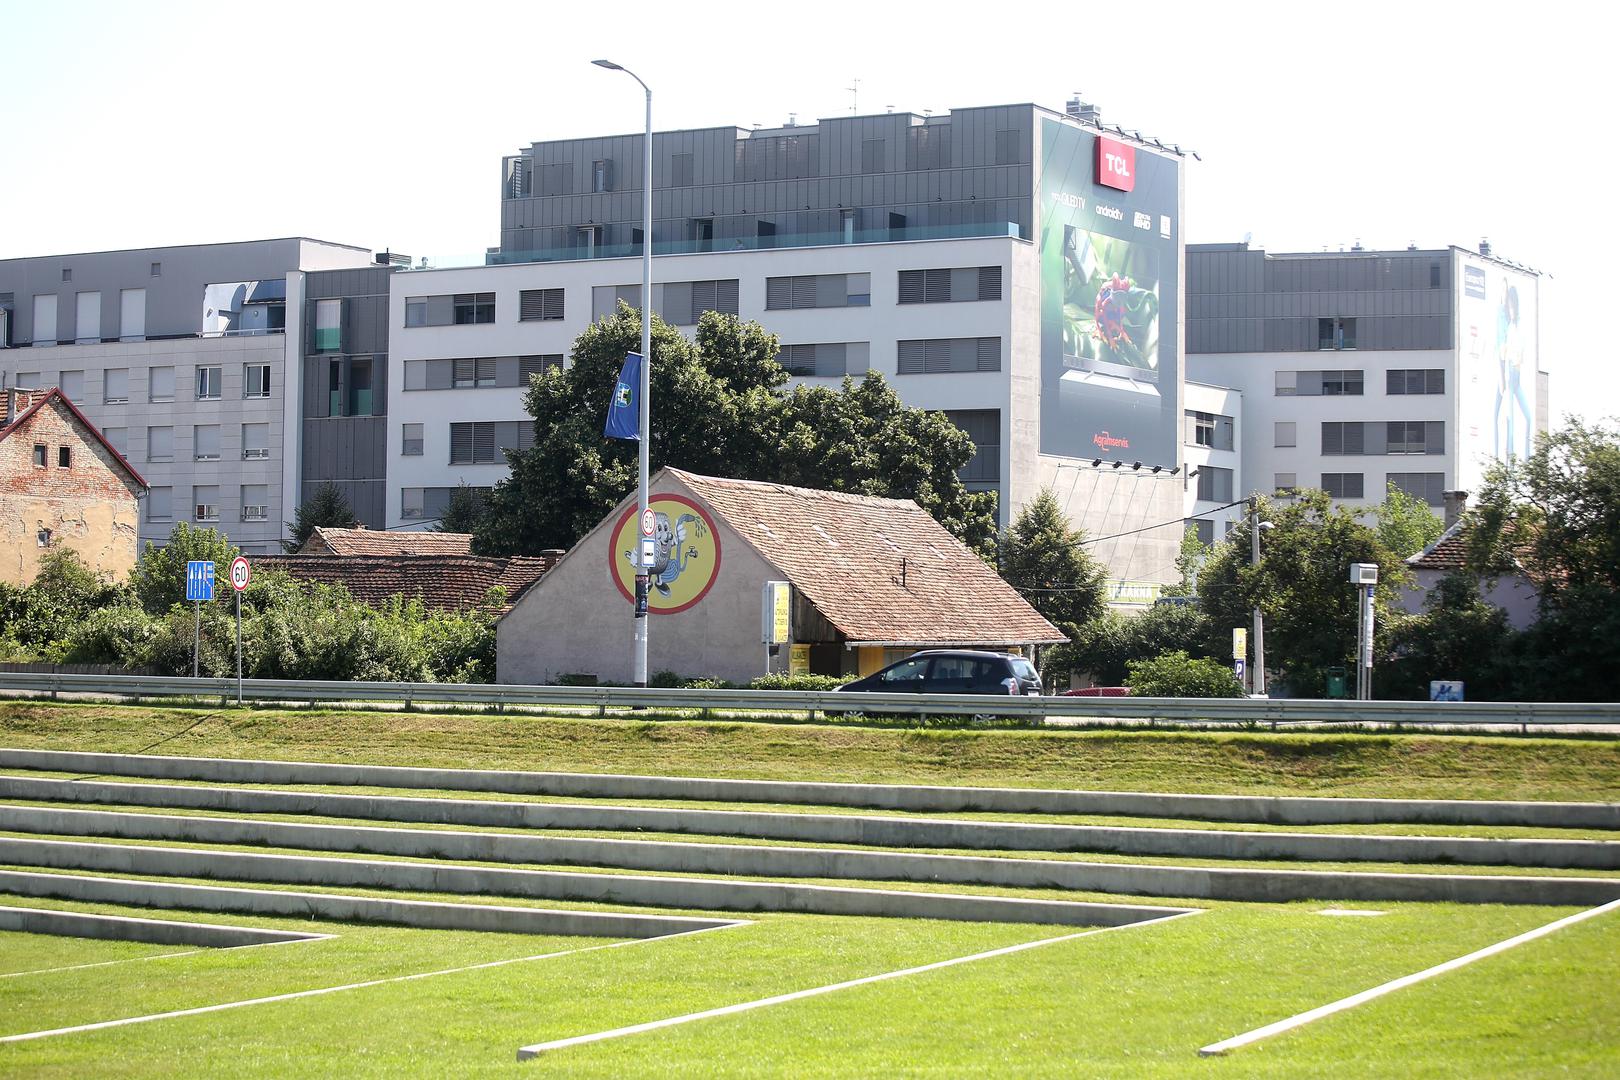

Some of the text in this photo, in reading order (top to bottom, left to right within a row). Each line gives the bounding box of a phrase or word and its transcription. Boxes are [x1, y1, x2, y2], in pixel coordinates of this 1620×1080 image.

[1105, 153, 1130, 177] TCL
[644, 516, 653, 529] 60
[234, 566, 246, 582] 60
